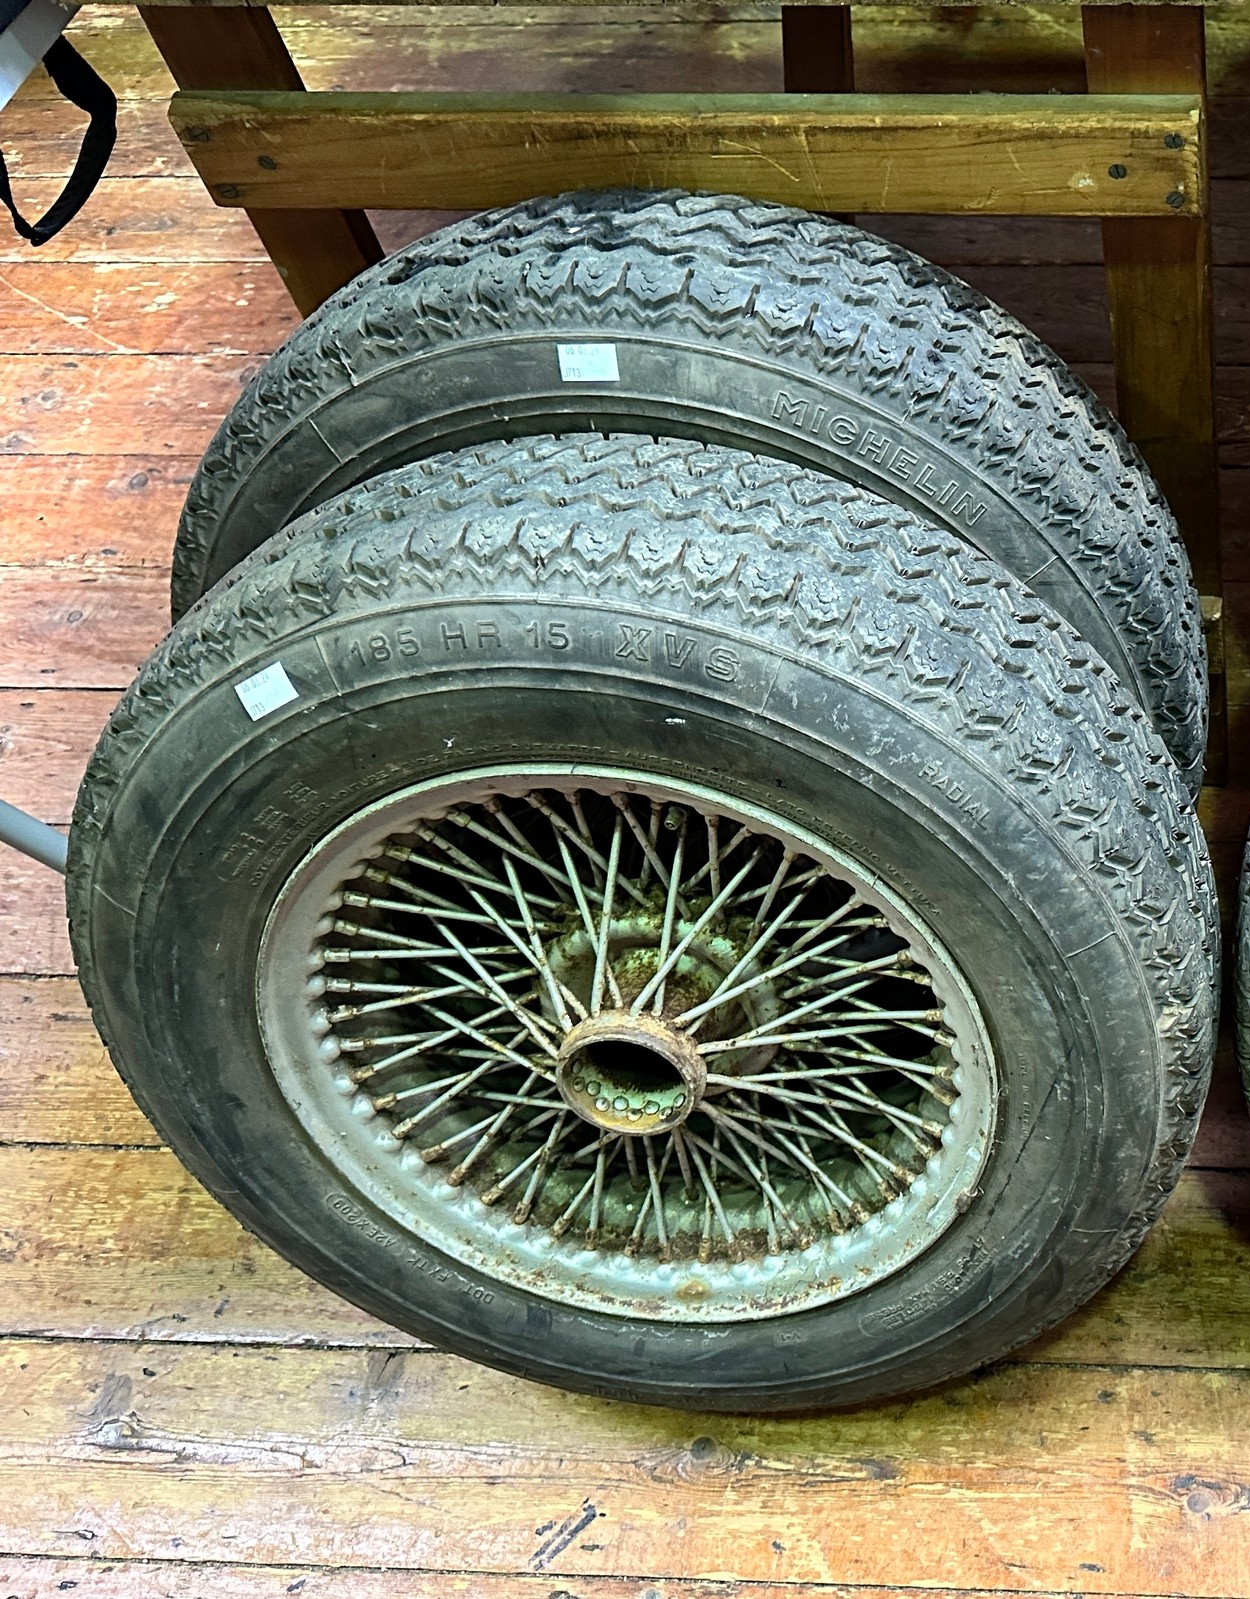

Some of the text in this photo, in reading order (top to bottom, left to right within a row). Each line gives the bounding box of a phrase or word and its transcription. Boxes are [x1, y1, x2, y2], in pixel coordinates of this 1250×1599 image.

[771, 390, 988, 528] MICHELIN
[350, 621, 743, 684] 185 HR 15 XVS
[917, 758, 993, 831] RADIAL
[462, 1284, 496, 1306] DOT
